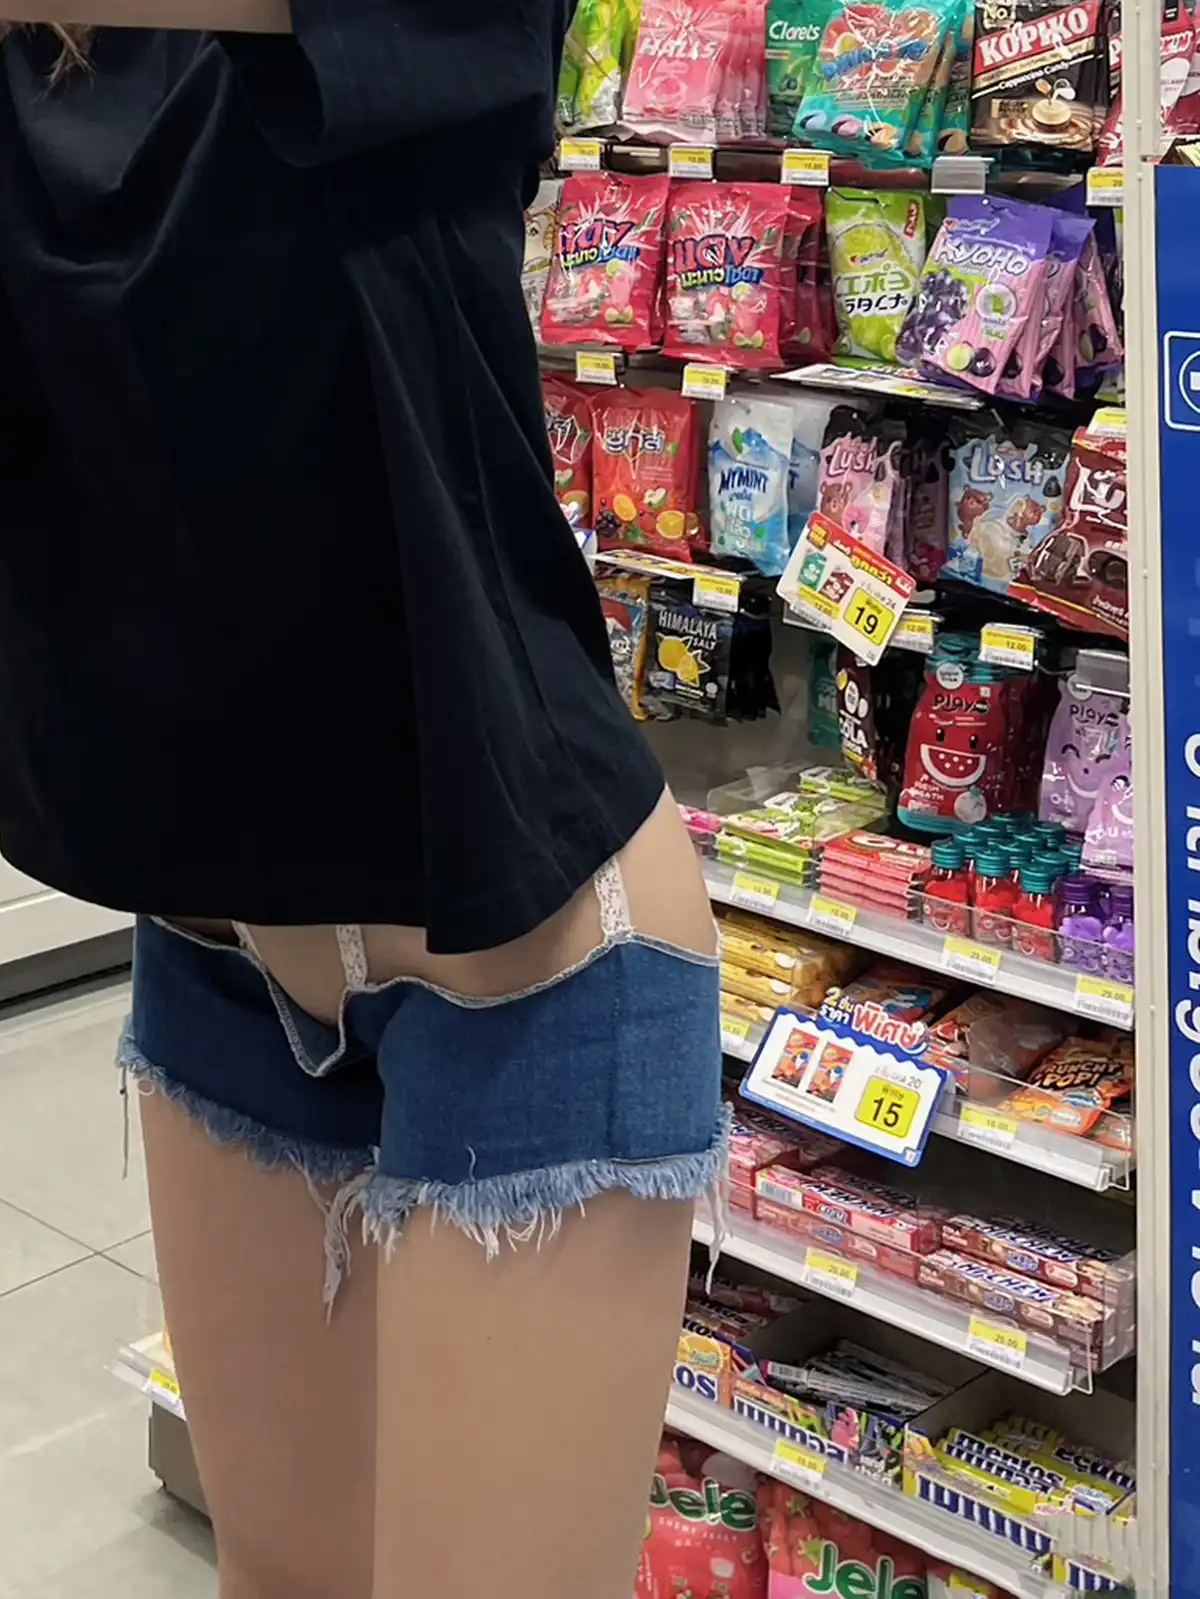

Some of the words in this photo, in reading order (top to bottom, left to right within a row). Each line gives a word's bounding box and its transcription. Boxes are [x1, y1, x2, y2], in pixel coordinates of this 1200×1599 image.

[637, 38, 719, 61] HALLS
[978, 6, 1090, 67] KOPIKO
[969, 445, 1044, 485] LUSH
[657, 610, 718, 640] HIMALAYA
[855, 606, 879, 634] 19
[690, 636, 717, 651] SALT
[1006, 640, 1028, 651] 12.00
[825, 987, 841, 1006] 2
[872, 1097, 903, 1130] 15
